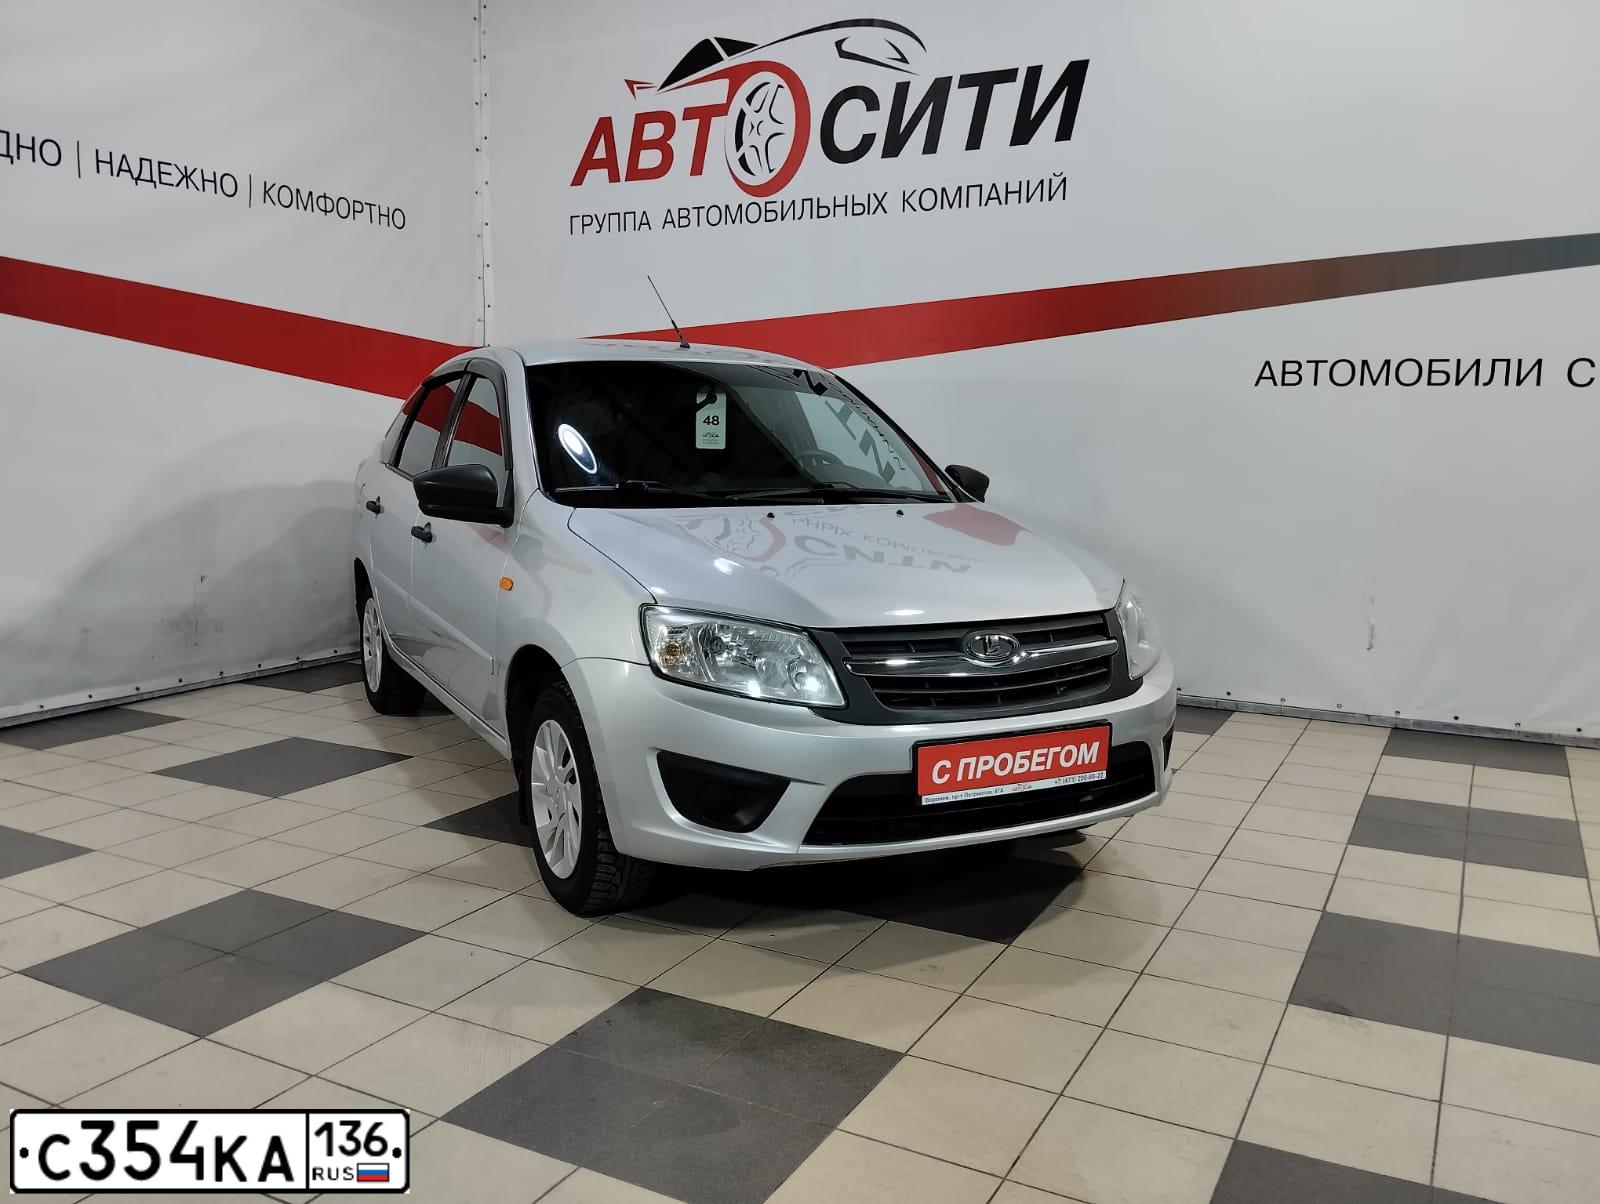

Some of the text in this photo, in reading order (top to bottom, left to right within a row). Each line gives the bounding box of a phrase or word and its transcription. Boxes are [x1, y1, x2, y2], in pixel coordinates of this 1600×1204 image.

[95, 148, 239, 198] НАДЕЖНО
[263, 180, 406, 230] КОМФОРТНО
[569, 172, 1068, 236] ГРУППА АВТОМОБИЛЬНЫХ КОМПАНИЙ
[1254, 357, 1596, 388] АВТОМОБИЛИ С
[703, 415, 720, 426] 48
[931, 741, 1101, 785] С ПРОБЕГОМ
